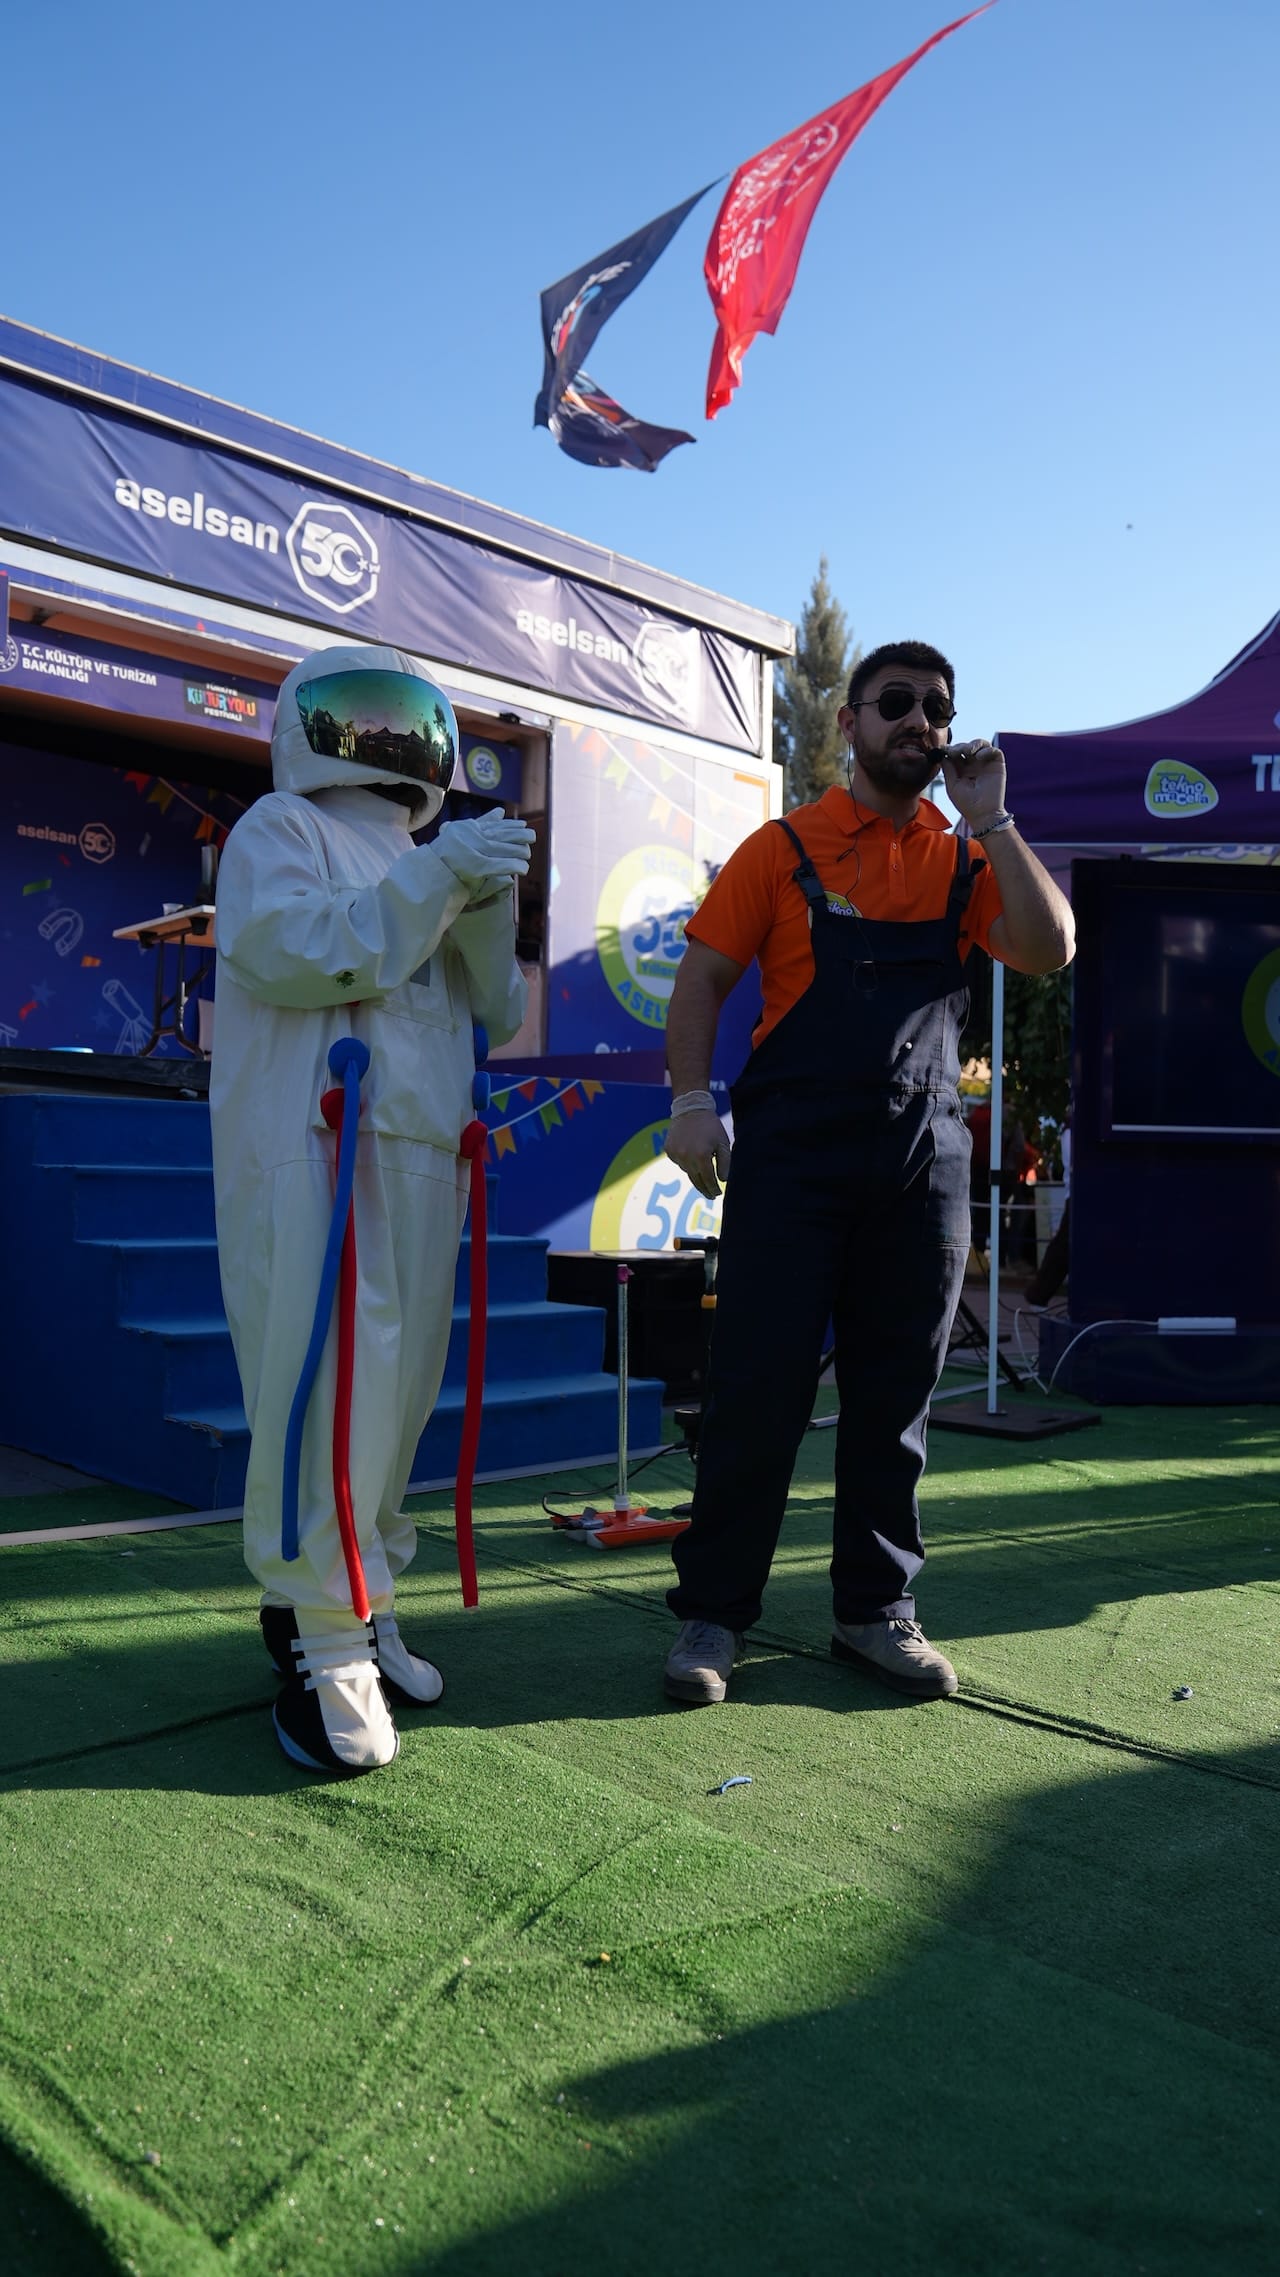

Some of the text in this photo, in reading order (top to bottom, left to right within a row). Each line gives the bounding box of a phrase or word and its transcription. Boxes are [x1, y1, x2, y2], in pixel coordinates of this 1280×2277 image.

[115, 478, 279, 554] aselsan
[516, 609, 630, 666] aselsan
[21, 643, 157, 686] T.C. KÜLTÜR VE TURİZM
[22, 657, 89, 683] BAKANLIĞI
[1161, 775, 1204, 794] tekno
[17, 824, 76, 845] aselsan
[617, 980, 669, 1023] ASEL
